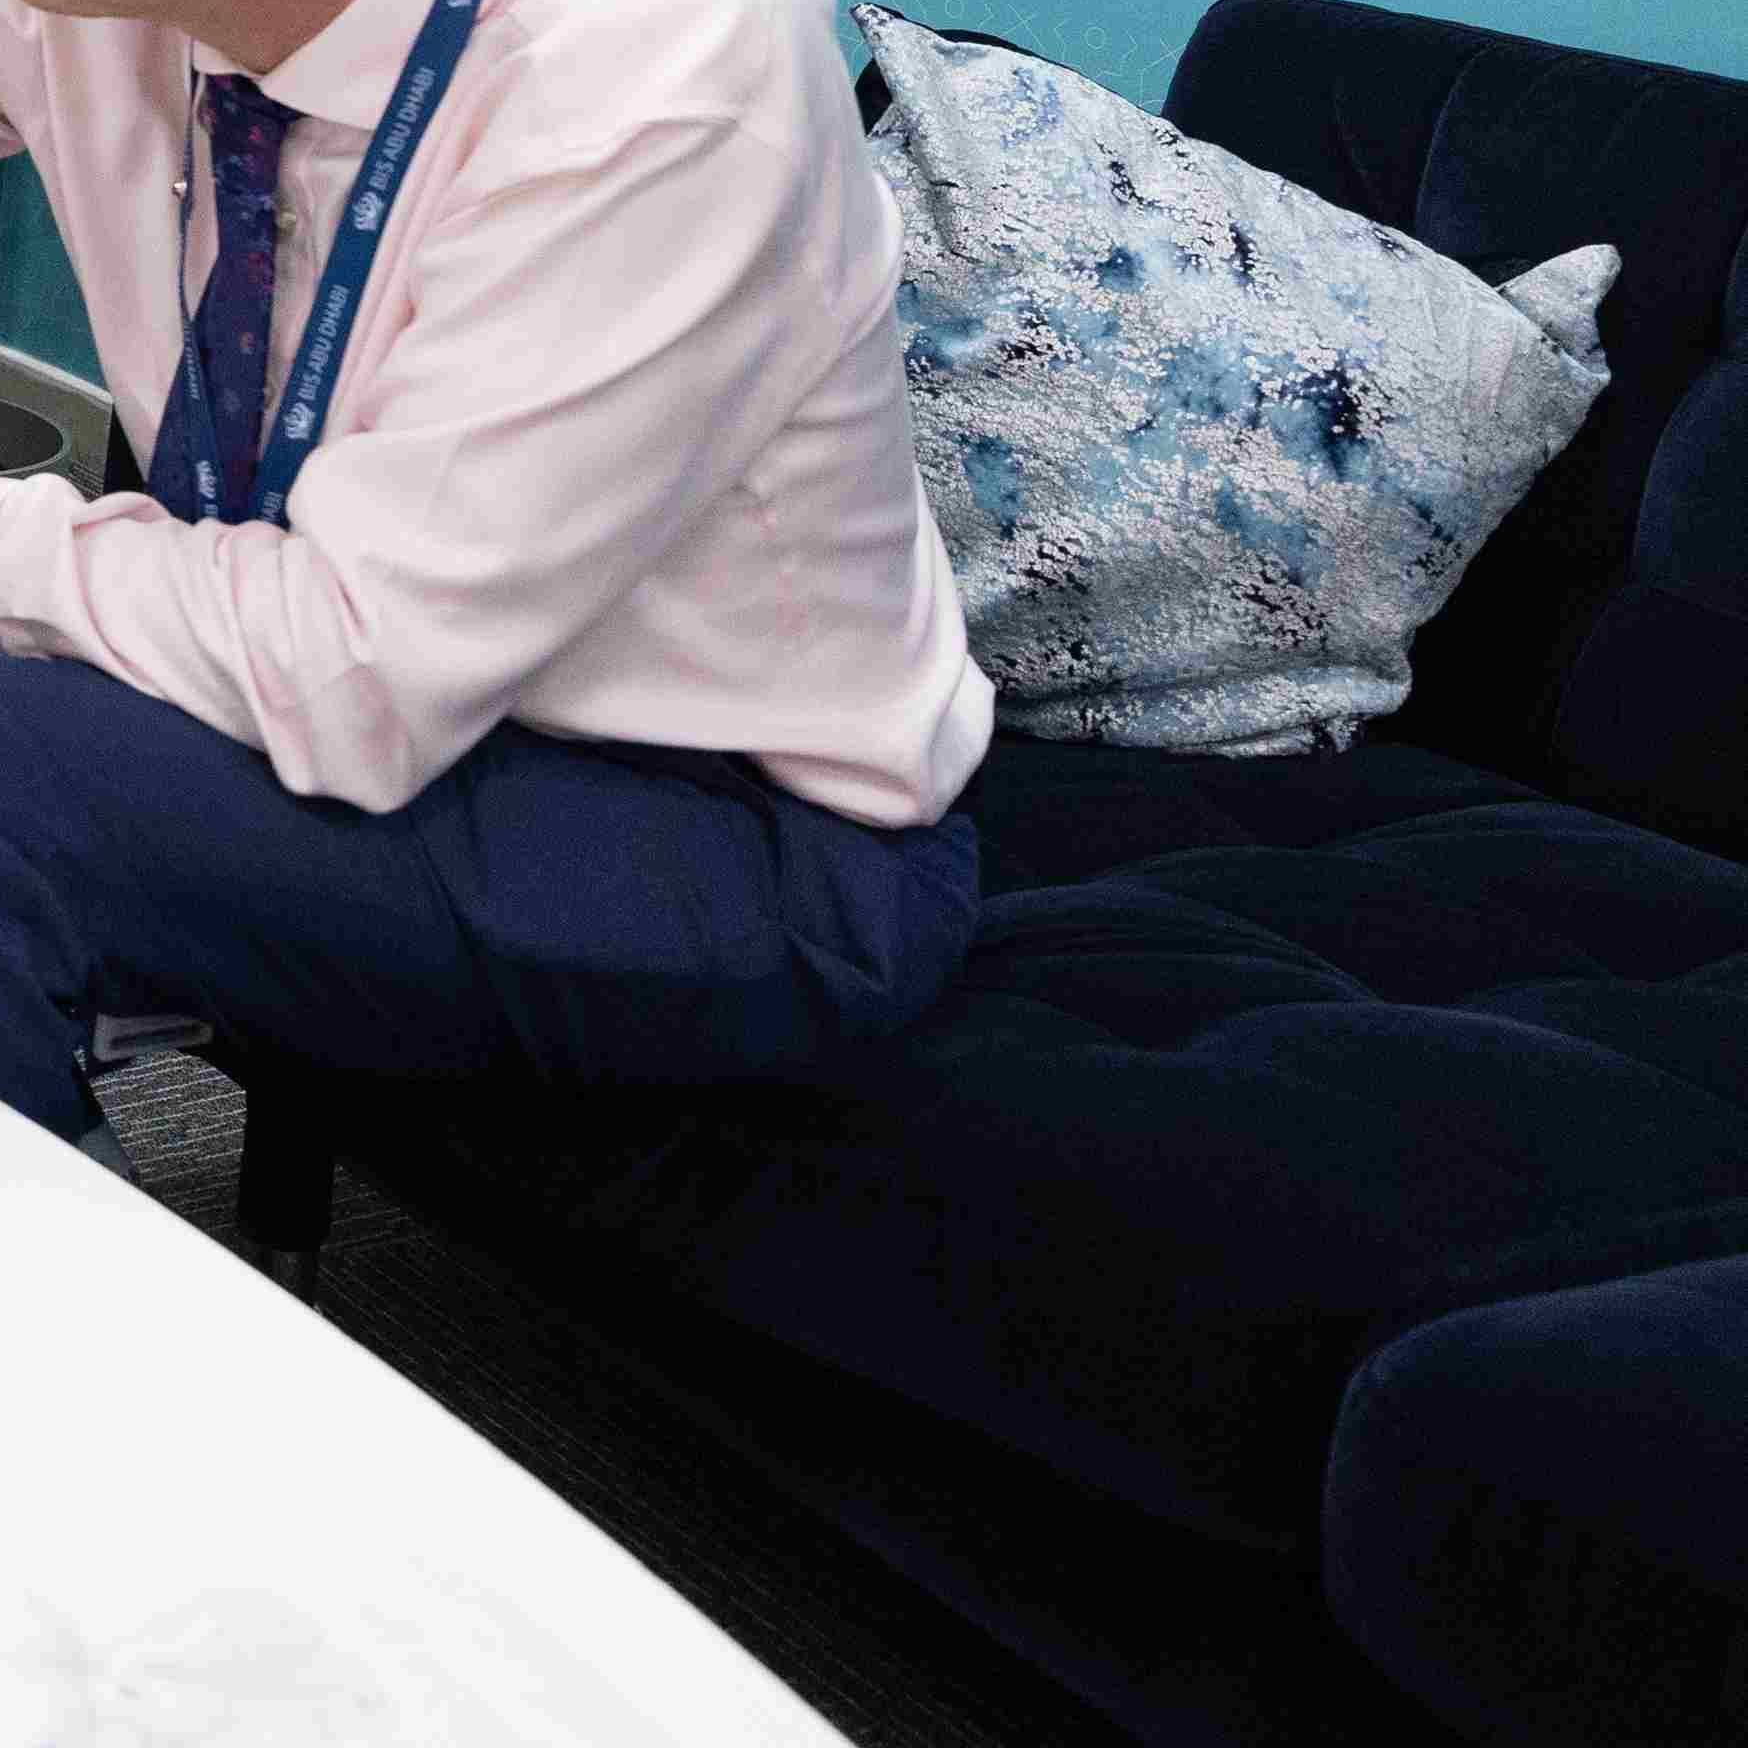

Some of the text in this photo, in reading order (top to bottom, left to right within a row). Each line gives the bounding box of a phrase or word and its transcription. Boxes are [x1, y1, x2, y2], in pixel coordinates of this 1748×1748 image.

[368, 67, 438, 190] BIS ABU DHABI
[297, 283, 349, 401] BIS ABU DHABI
